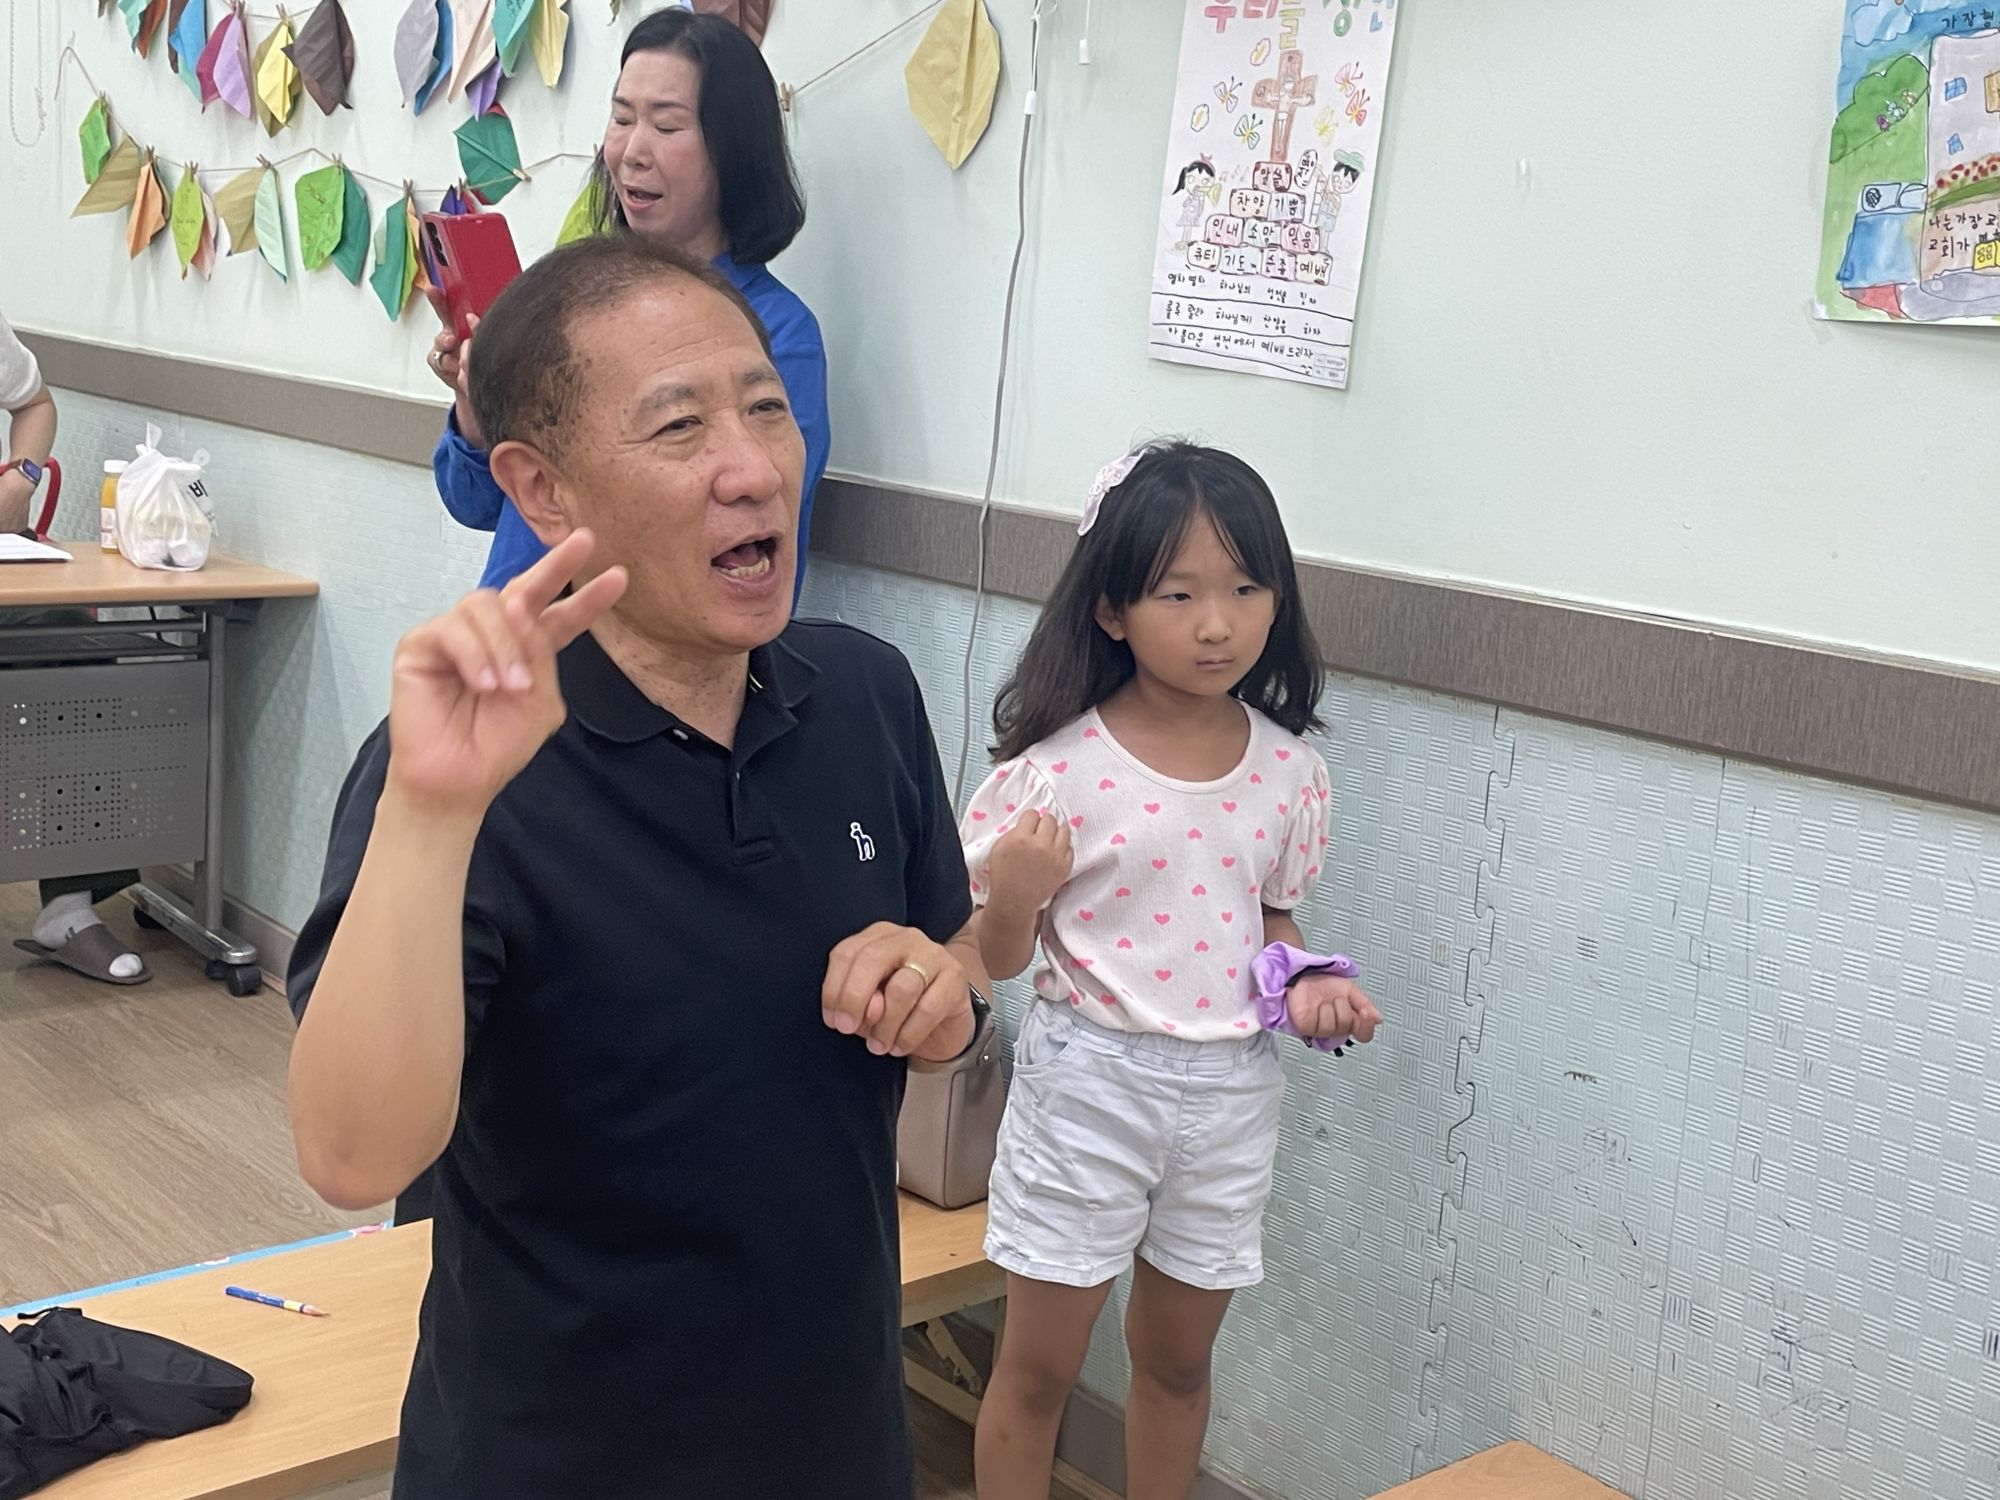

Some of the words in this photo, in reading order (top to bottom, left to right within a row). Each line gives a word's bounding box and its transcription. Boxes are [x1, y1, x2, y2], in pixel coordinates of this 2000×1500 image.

[1237, 192, 1264, 215] 찬양
[1274, 197, 1299, 216] 기쁨
[1212, 218, 1240, 238] 인내
[1248, 223, 1275, 245] 소망
[1288, 226, 1313, 249] 믿음
[1194, 247, 1216, 262] 큐티
[1224, 254, 1246, 272] 기도
[1265, 253, 1286, 276] 순종
[1299, 259, 1328, 279] 예배
[1215, 307, 1253, 326] 하나님께
